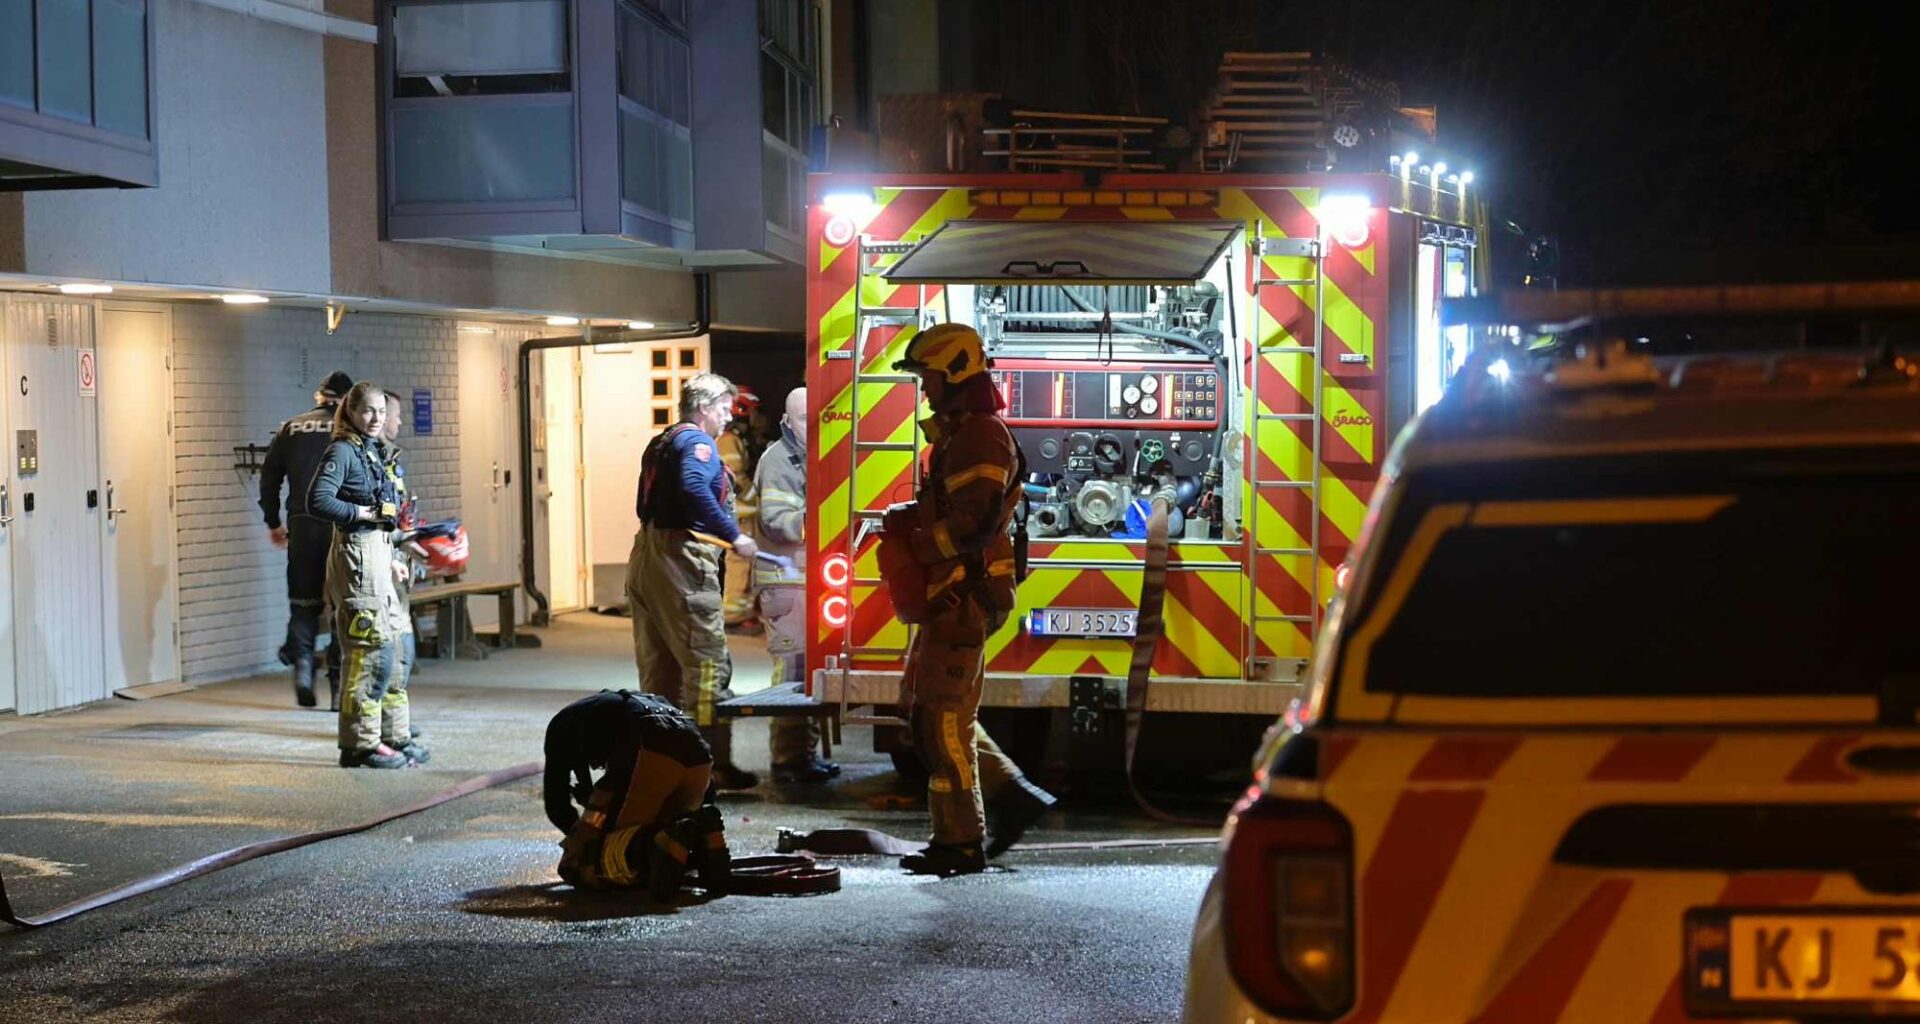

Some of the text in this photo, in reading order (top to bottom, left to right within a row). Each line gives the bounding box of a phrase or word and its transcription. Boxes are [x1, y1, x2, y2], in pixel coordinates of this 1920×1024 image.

[20, 375, 28, 396] C
[289, 420, 334, 436] POLI
[1050, 613, 1131, 633] KJ 3525
[1755, 927, 1920, 990] KJ 5
